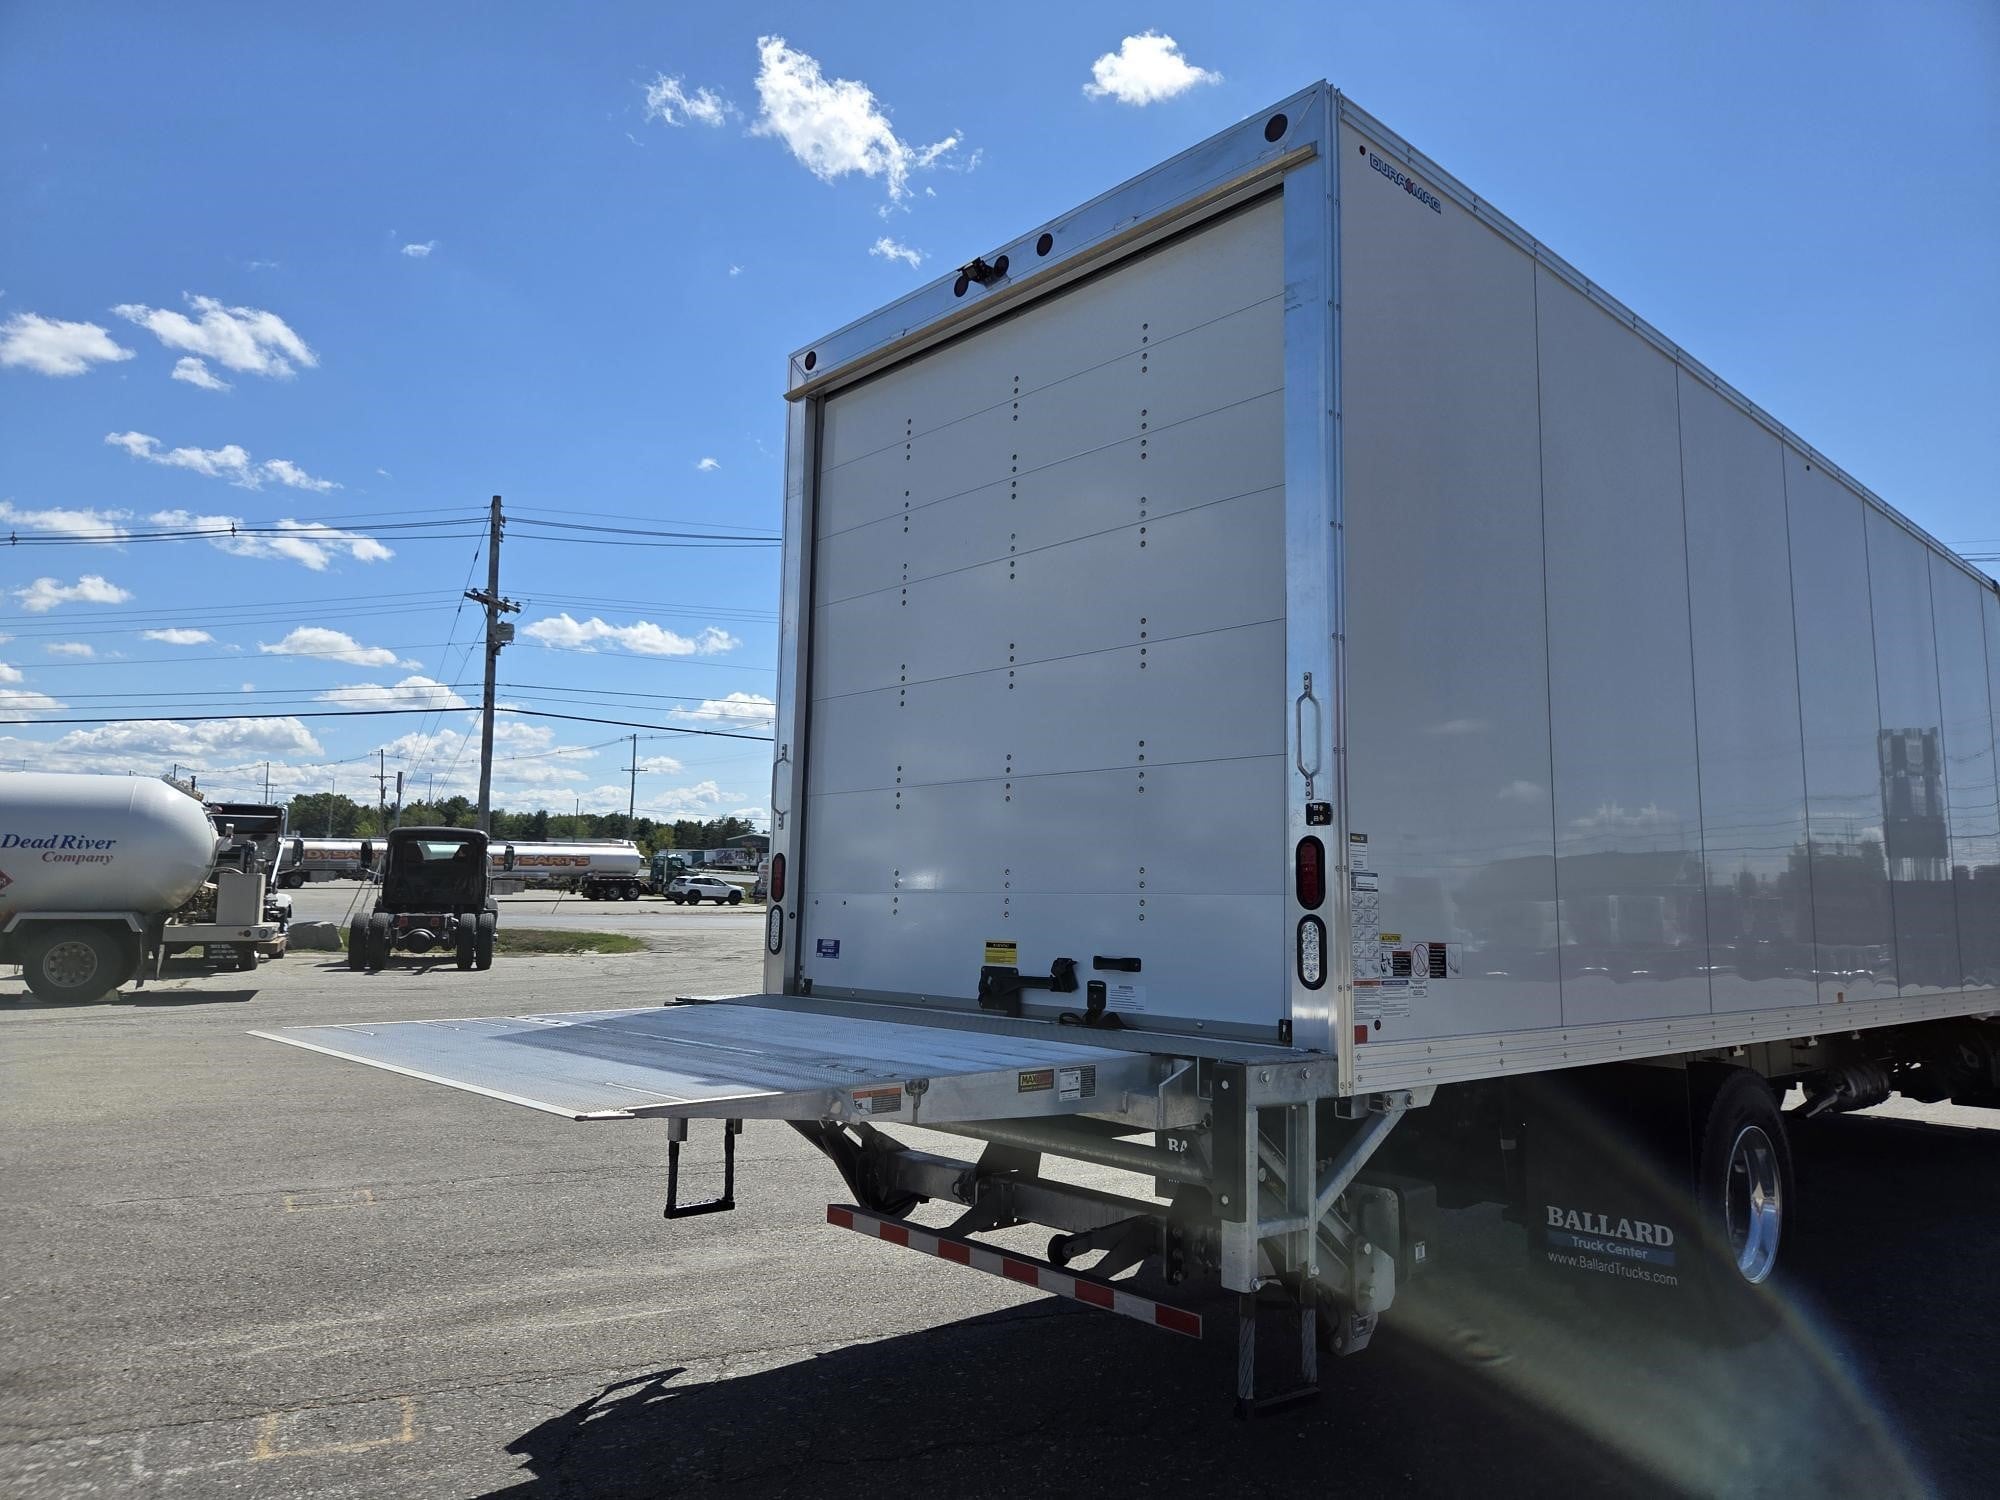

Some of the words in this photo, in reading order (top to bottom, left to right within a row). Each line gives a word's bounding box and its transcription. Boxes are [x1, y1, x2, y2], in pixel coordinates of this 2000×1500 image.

[1, 833, 59, 849] Dead
[59, 834, 117, 850] River
[42, 851, 114, 866] Company
[1547, 1205, 1674, 1246] BALLARD
[1572, 1236, 1605, 1252] Truck
[1606, 1243, 1648, 1259] Center
[1548, 1252, 1678, 1287] www.BallardTrucks.com
